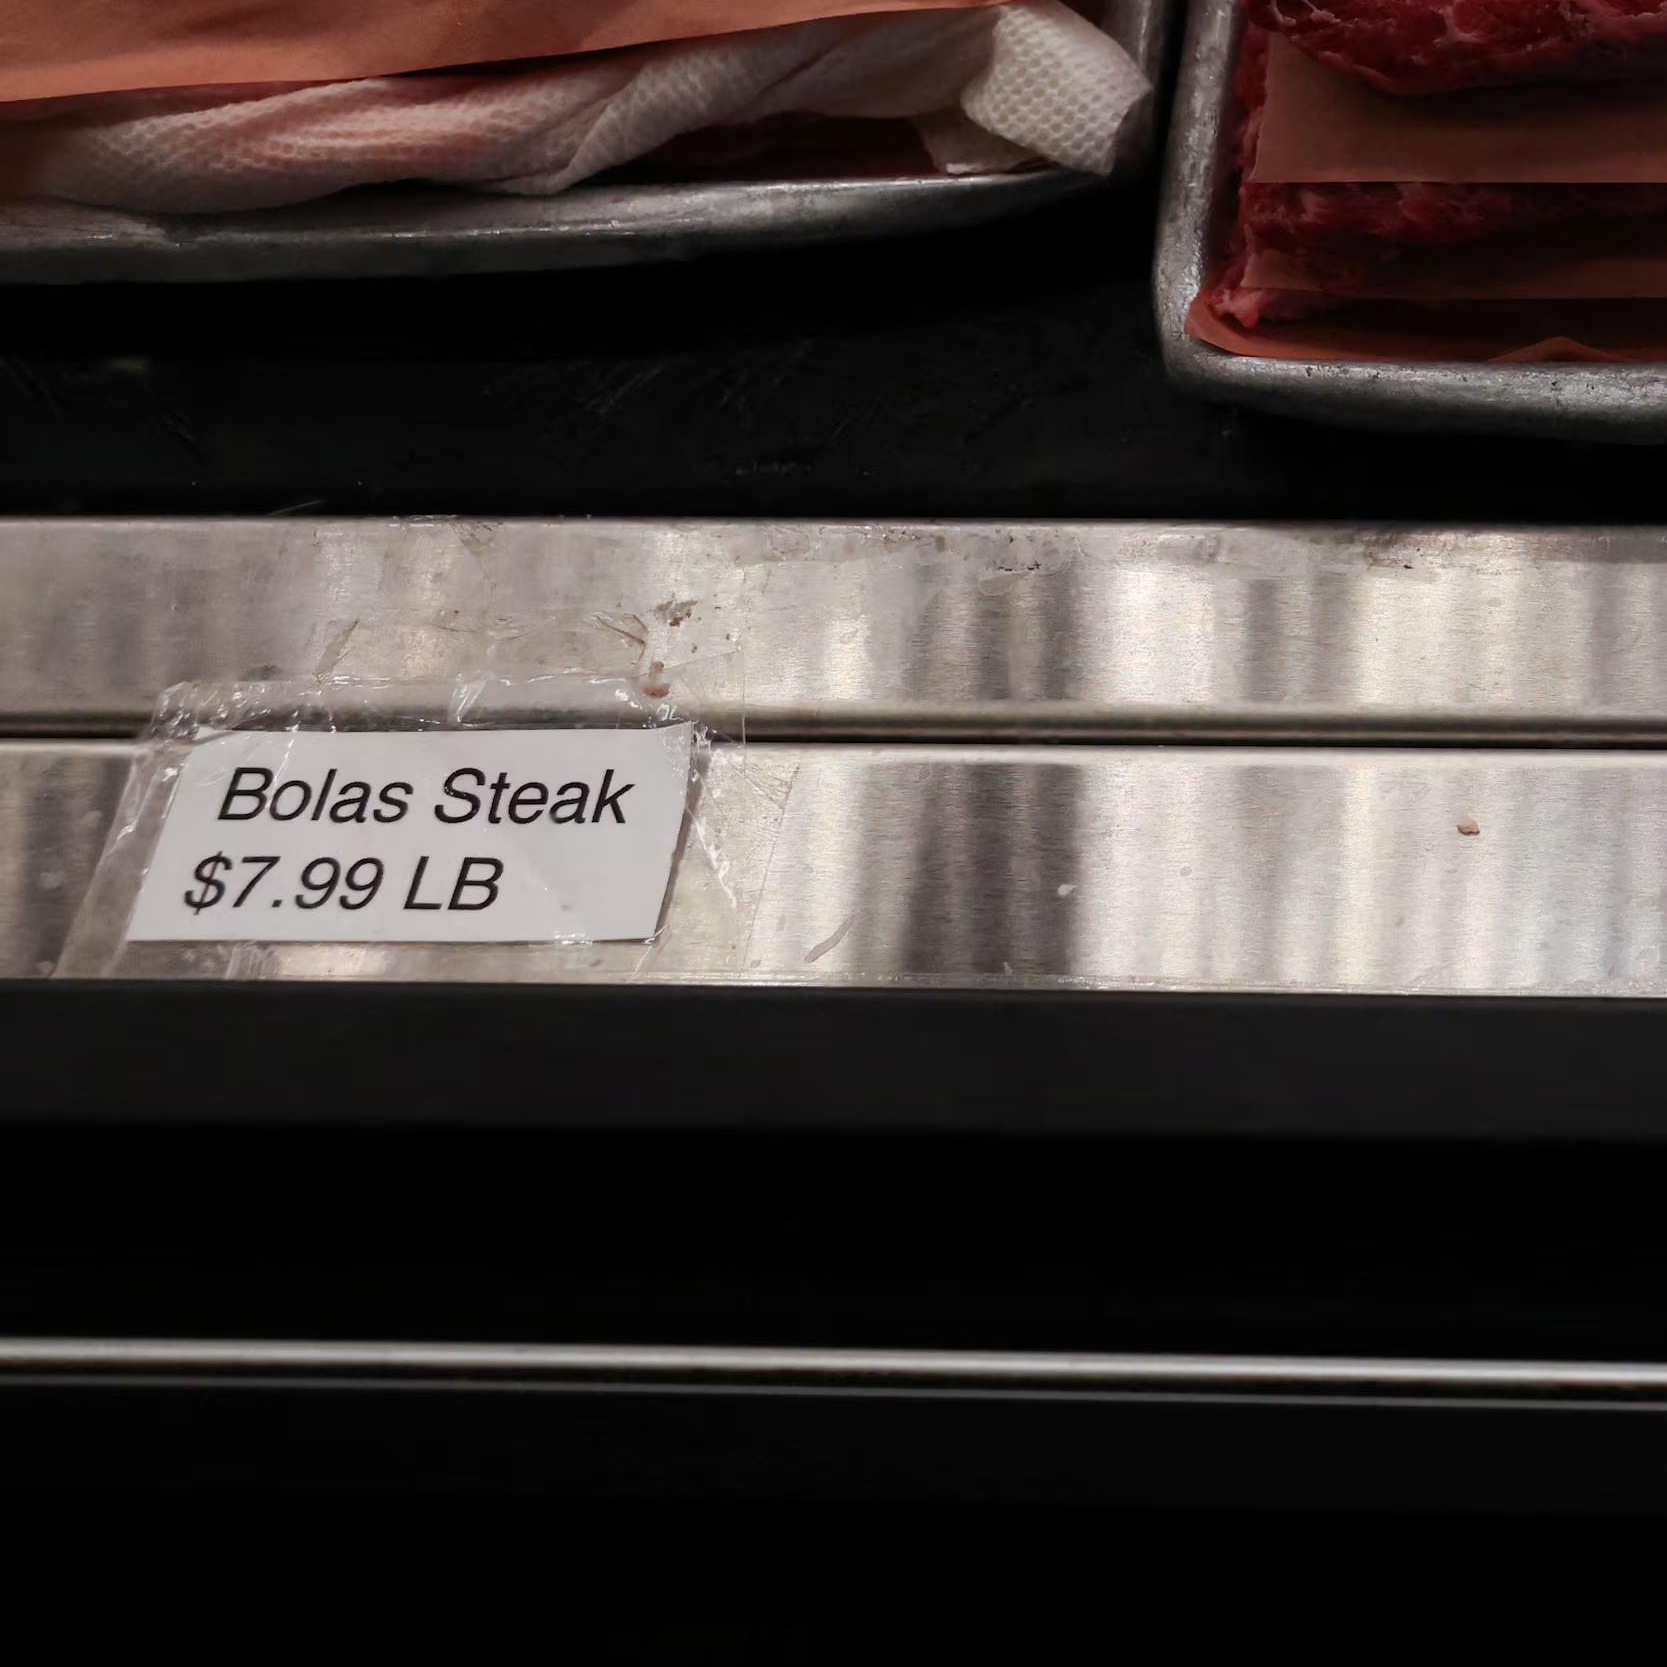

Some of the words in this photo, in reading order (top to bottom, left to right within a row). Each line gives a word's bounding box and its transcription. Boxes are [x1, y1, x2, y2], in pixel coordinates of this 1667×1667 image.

[217, 766, 413, 824] Bolas
[433, 768, 636, 825] Steak
[183, 852, 384, 916] $7.99
[403, 855, 506, 911] LB
